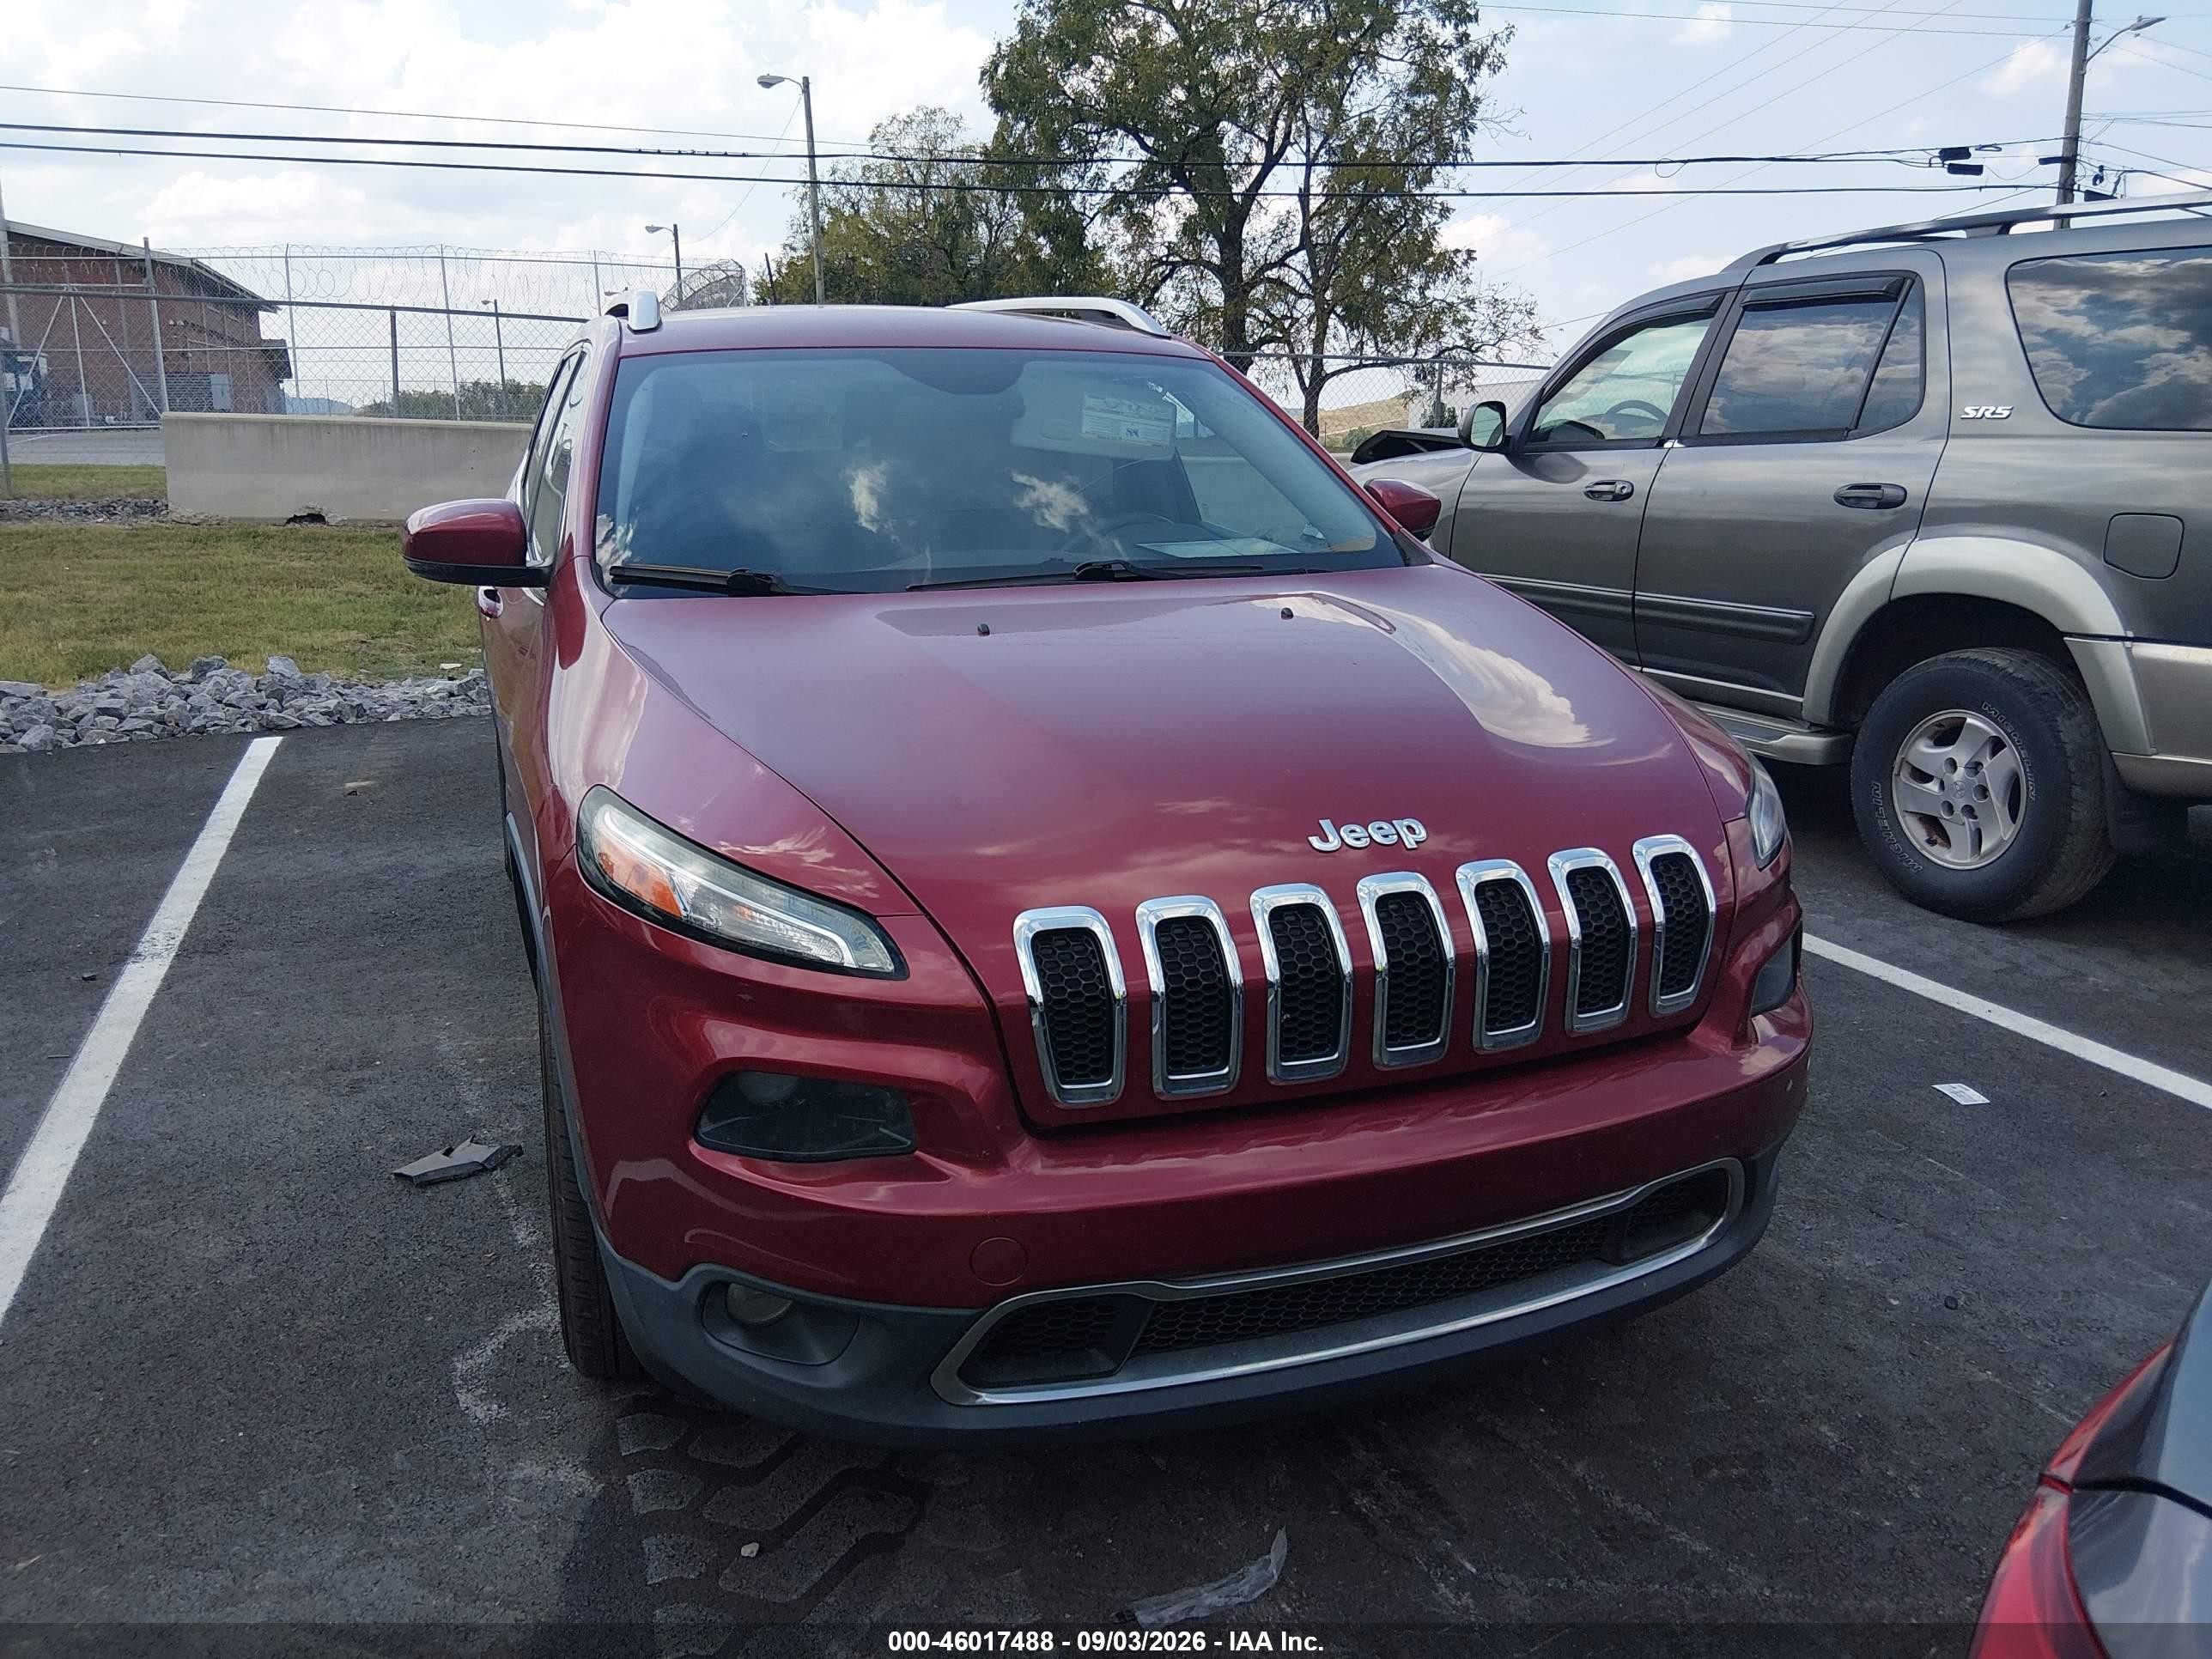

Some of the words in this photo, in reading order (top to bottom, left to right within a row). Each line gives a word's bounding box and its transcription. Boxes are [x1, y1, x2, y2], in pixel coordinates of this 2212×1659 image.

[1960, 405, 2014, 419] SR5
[1308, 818, 1427, 852] Jeep
[1870, 781, 1923, 873] MICHELIN
